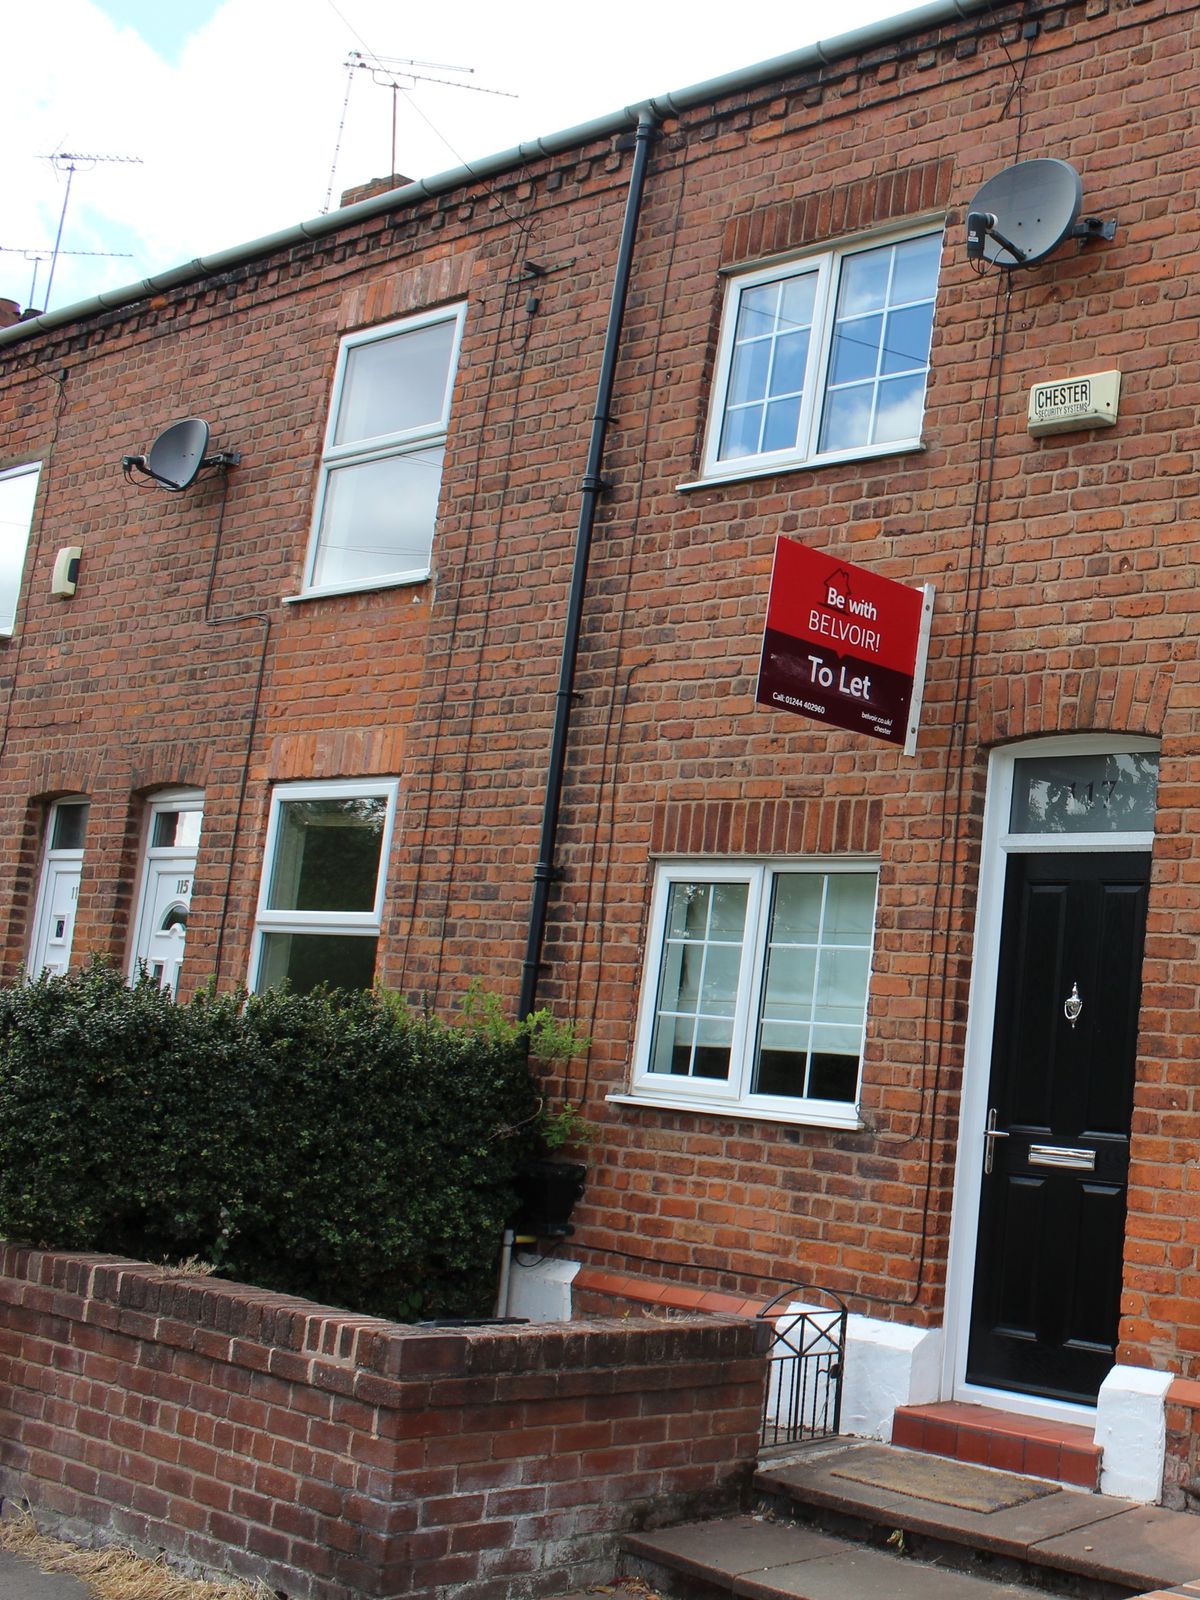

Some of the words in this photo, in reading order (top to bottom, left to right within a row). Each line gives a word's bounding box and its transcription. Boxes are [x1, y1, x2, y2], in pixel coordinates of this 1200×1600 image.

[1037, 384, 1088, 408] CHESTER
[1038, 407, 1062, 418] SECURITY
[1063, 402, 1088, 415] SYSTEMS
[827, 586, 845, 609] Be
[849, 599, 878, 621] with
[808, 610, 881, 652] BELVOIR!
[808, 655, 833, 688] To
[839, 667, 871, 700] Let
[785, 696, 803, 708] 01244
[803, 701, 826, 714] 402960
[176, 879, 190, 894] 115
